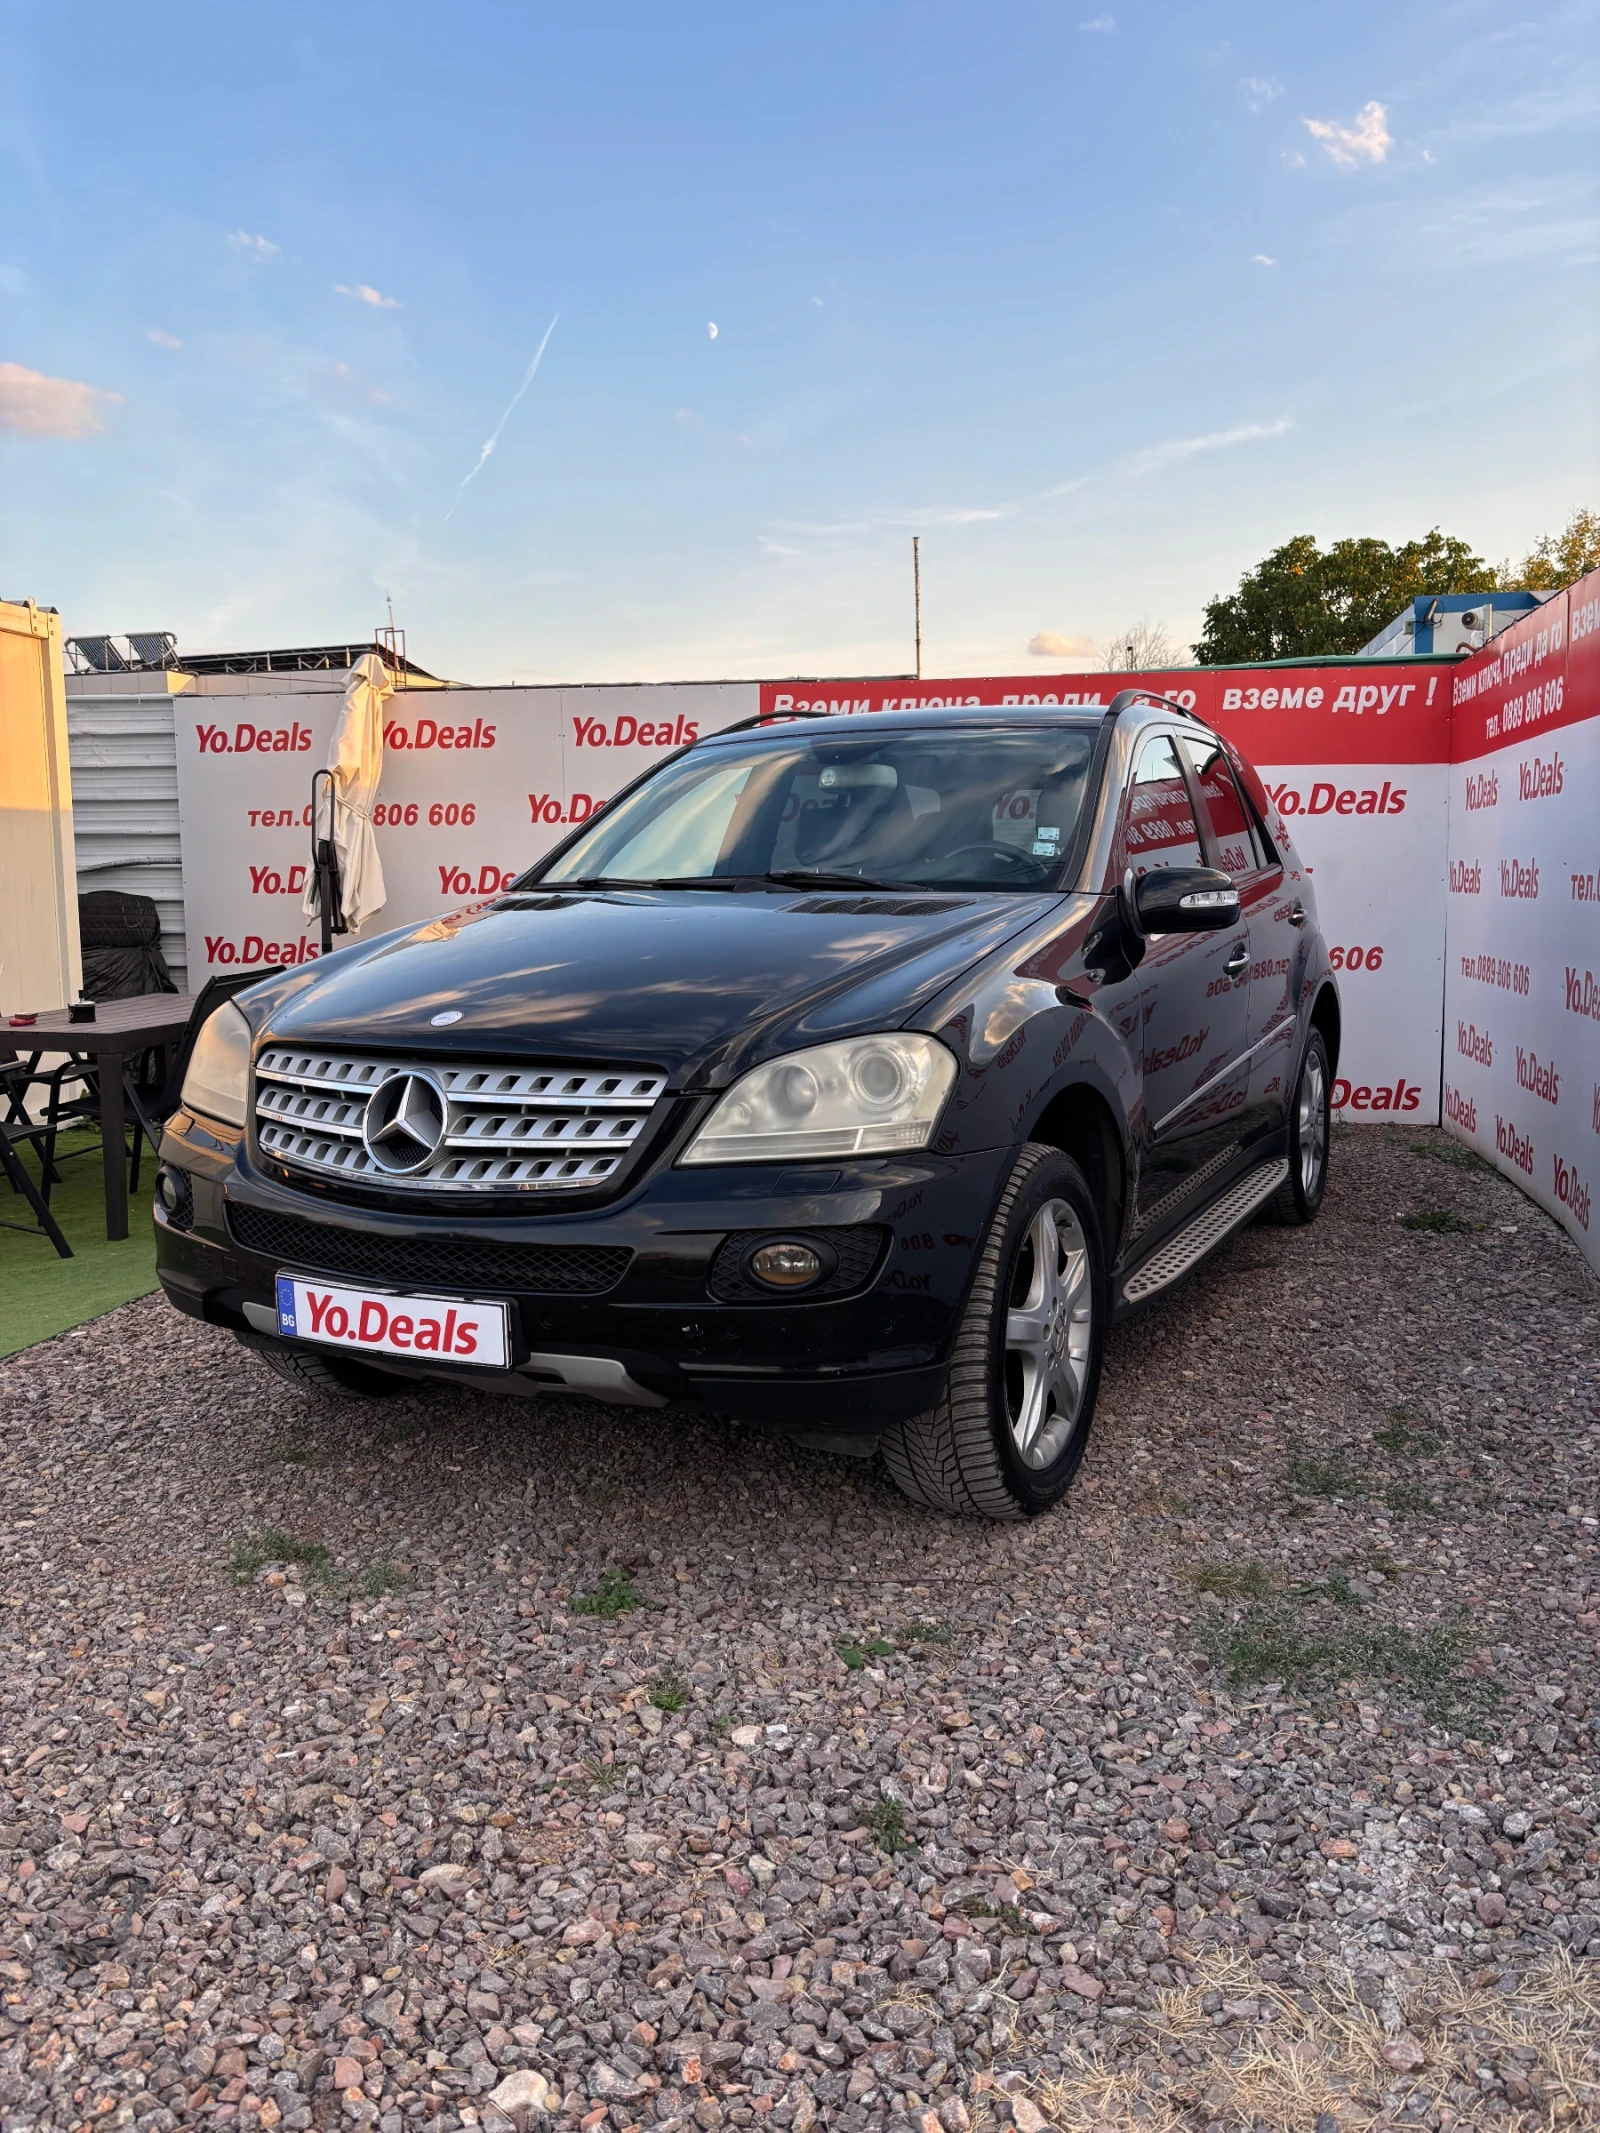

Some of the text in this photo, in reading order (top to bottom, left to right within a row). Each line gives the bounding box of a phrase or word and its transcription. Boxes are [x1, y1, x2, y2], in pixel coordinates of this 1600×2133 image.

[1453, 674, 1477, 707] Вземи
[1503, 638, 1533, 684] преди
[1534, 630, 1548, 668] да
[1550, 620, 1563, 653] го
[1222, 686, 1324, 710] вземе
[1332, 684, 1416, 715] друг
[1425, 677, 1438, 706] !
[1486, 676, 1564, 740] тел. 0889 806 606
[195, 722, 312, 753] Yo.Deals
[572, 714, 699, 747] Yo.Deals
[1465, 769, 1498, 811] Yo.Deals
[1519, 751, 1564, 801] Yo.Deals
[247, 803, 477, 827] тел.0 806 606
[1264, 782, 1407, 816] Yo.Deals
[1449, 859, 1482, 894] Yo.Deals
[1500, 857, 1539, 899] Yo.Deals
[204, 936, 320, 964] Yo.Deals
[1329, 946, 1384, 971] 606
[1461, 954, 1496, 985] тел.0889
[1513, 963, 1530, 996] 606
[1458, 1020, 1492, 1067] Yo.Deals
[1330, 1079, 1421, 1111] Deals
[1516, 1045, 1559, 1105] Yo.Deals
[1445, 1082, 1476, 1133] Yo.Deals
[1496, 1114, 1533, 1175] Yo.Deals
[1553, 1153, 1591, 1231] Yo.Deals
[282, 1313, 296, 1327] BG
[306, 1291, 479, 1355] Yo.Deals
